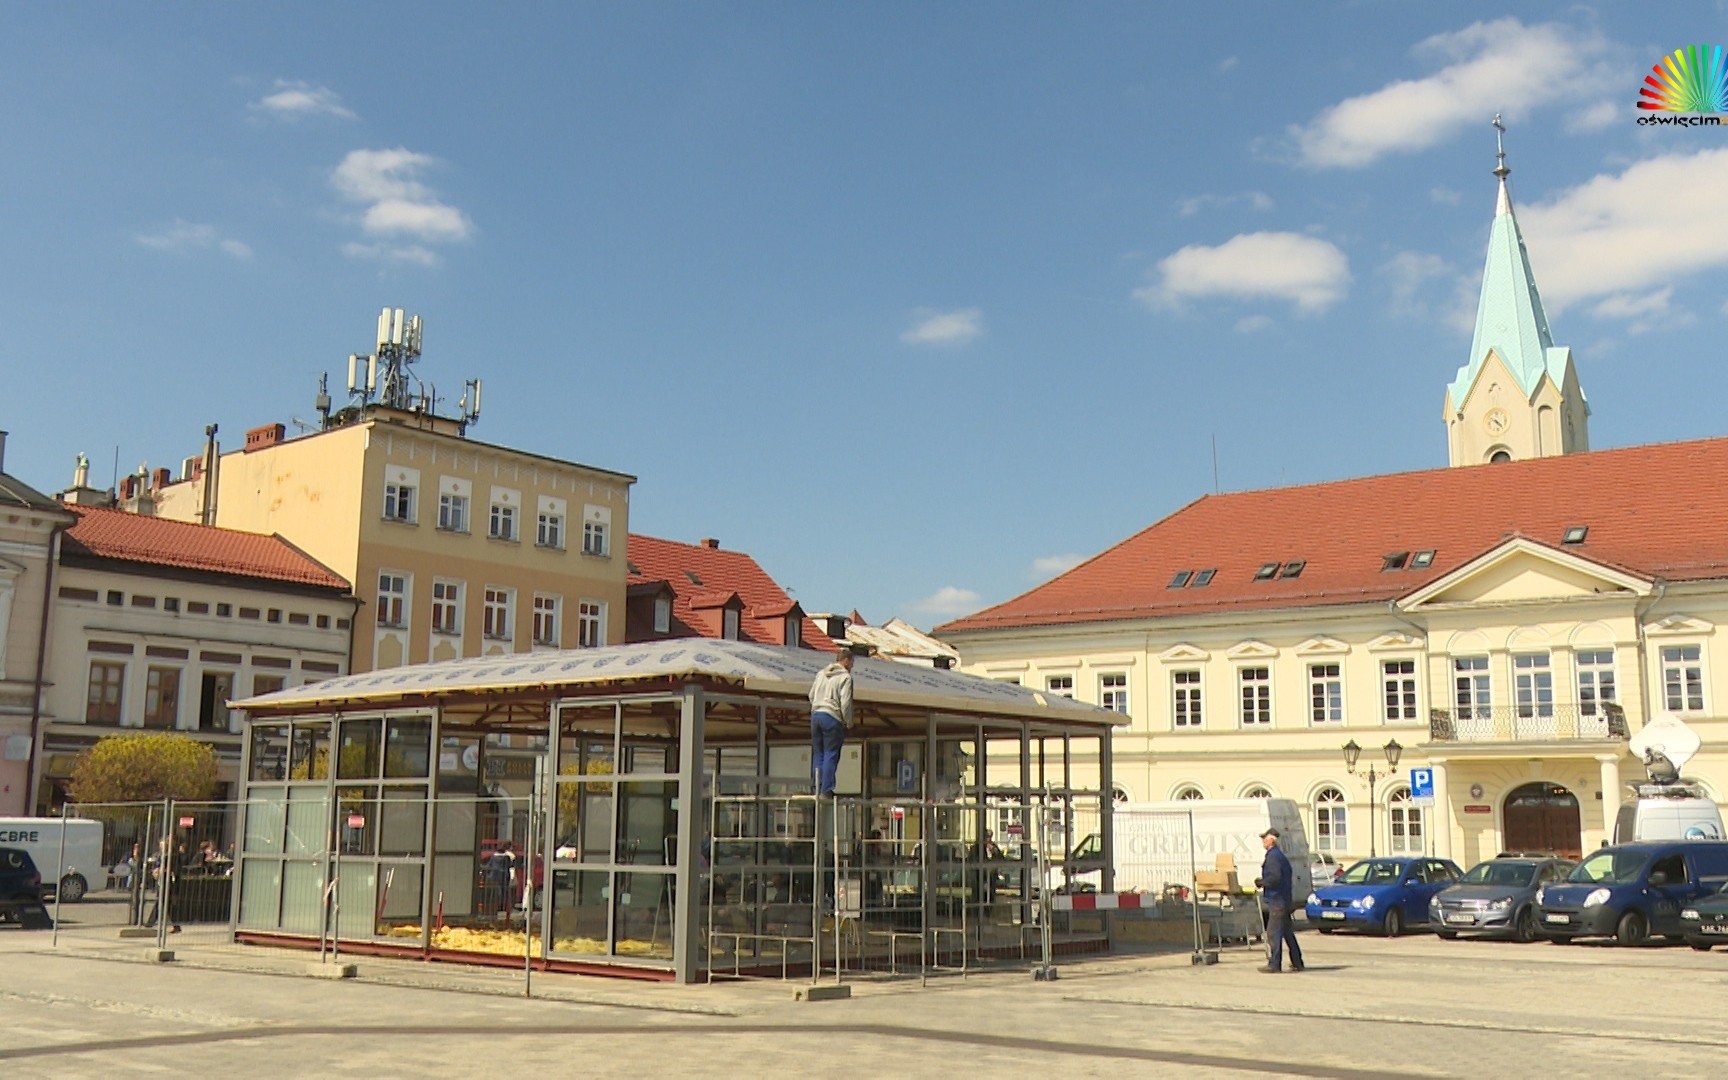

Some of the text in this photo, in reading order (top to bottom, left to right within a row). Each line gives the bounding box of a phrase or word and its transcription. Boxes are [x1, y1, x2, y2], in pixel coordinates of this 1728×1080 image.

[902, 764, 911, 786] P
[1415, 770, 1429, 788] P
[1129, 834, 1251, 854] GREMIX
